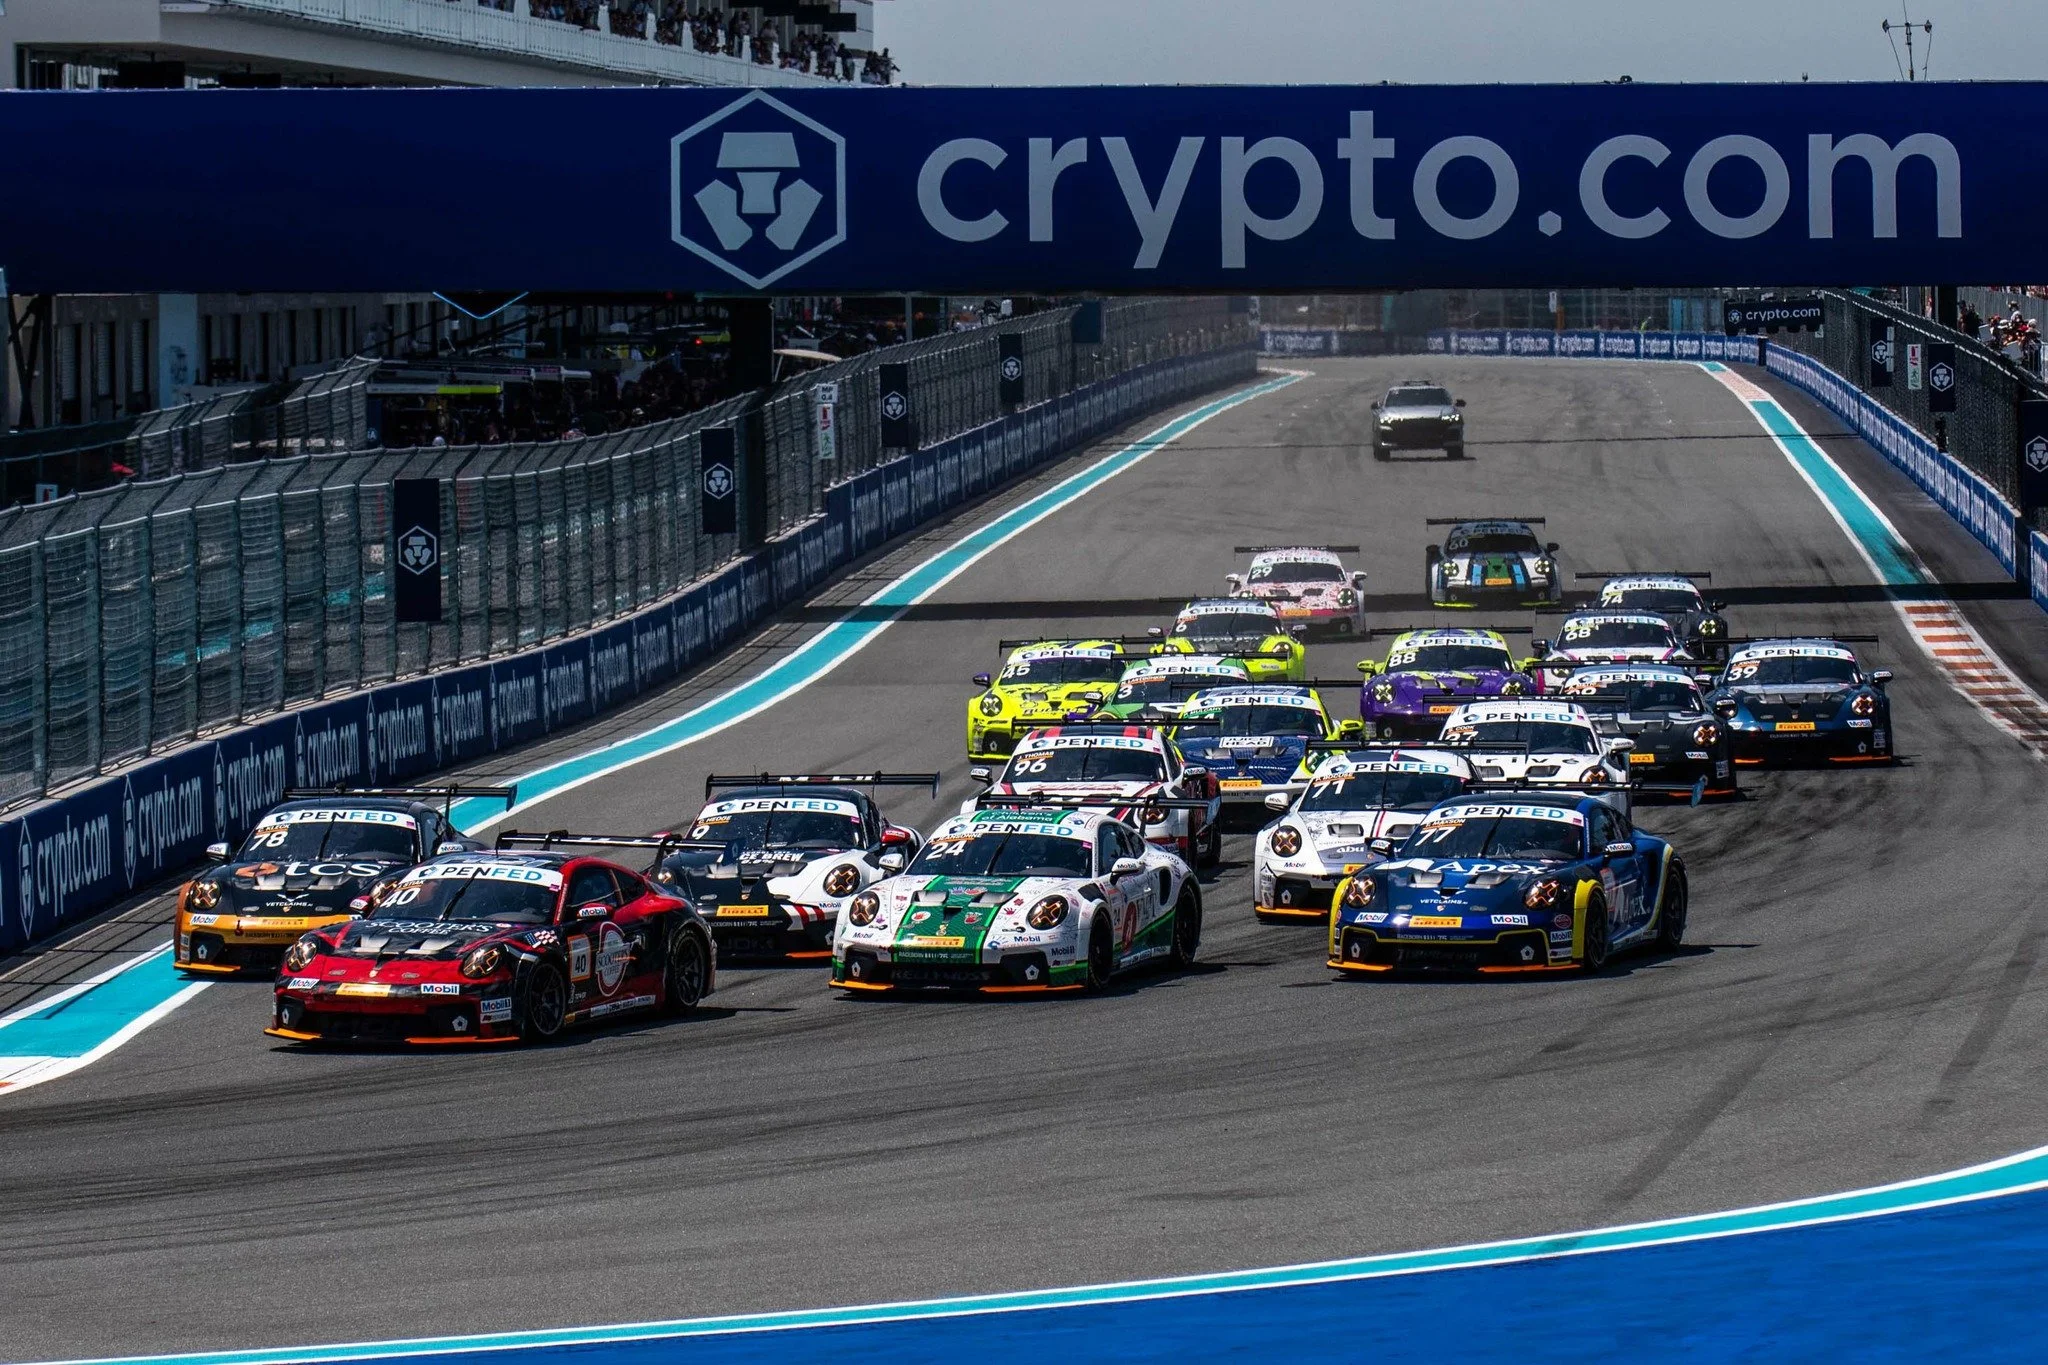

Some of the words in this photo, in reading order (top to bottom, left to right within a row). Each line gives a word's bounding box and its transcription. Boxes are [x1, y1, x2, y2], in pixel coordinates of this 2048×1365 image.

[916, 109, 1963, 271] crypto.com
[1745, 305, 1821, 321] crypto.com
[1251, 566, 1273, 580] 29
[1600, 594, 1624, 608] 74
[1204, 605, 1266, 614] PENFED
[1175, 622, 1187, 632] 6
[1593, 617, 1657, 625] PENFED
[1565, 629, 1592, 642] 68
[1423, 638, 1493, 646] PENFED
[1039, 650, 1111, 658] PENFED
[1764, 648, 1839, 657] PENFED
[1389, 652, 1417, 668] 88
[1002, 663, 1031, 680] 45
[1155, 665, 1231, 674] PENFED
[1727, 666, 1759, 682] 39
[1600, 674, 1679, 682] PENFED
[1117, 684, 1133, 700] 3
[1221, 696, 1305, 706] PENFED
[1486, 712, 1573, 723] PENFED
[1778, 723, 1814, 731] PIRELLI
[378, 697, 426, 776] crypto.com
[1445, 731, 1479, 741] 27
[1054, 737, 1144, 748] PENFED
[307, 717, 360, 788] crypto.com
[1013, 758, 1047, 777] 96
[1354, 762, 1450, 774] PENFED
[227, 742, 286, 831] crypto.com
[1312, 779, 1347, 799] 71
[741, 800, 840, 812] PENFED
[298, 811, 398, 823] PENFED
[1463, 806, 1565, 819] PENFED
[138, 770, 203, 869] crypto.com
[996, 815, 1054, 823] Alabama
[691, 825, 710, 840] 9
[972, 822, 1074, 837] PENFED
[249, 831, 289, 852] 78
[1414, 827, 1456, 847] 77
[926, 840, 965, 860] 24
[37, 813, 111, 917] crypto.com
[284, 861, 384, 877] tcs
[1284, 861, 1306, 869] Mobil
[1431, 860, 1551, 876] Apex
[441, 866, 543, 881] PENFED
[379, 888, 421, 909] 40
[581, 907, 606, 917] Mobil
[720, 906, 765, 916] PIRELLI
[1356, 912, 1387, 922] Mobil
[191, 915, 217, 925] Mobil
[1412, 917, 1459, 927] PIRELLI
[1492, 914, 1527, 924] Mobil
[365, 920, 494, 933] SCOOTER'S
[388, 926, 451, 935] COFFEE
[852, 931, 875, 940] Mobil
[1013, 935, 1041, 943] Mobil
[1051, 947, 1071, 957] Mobil
[574, 953, 586, 974] 40
[289, 978, 317, 989] Mobil
[422, 984, 459, 994] Mobil
[482, 999, 507, 1012] Mobil
